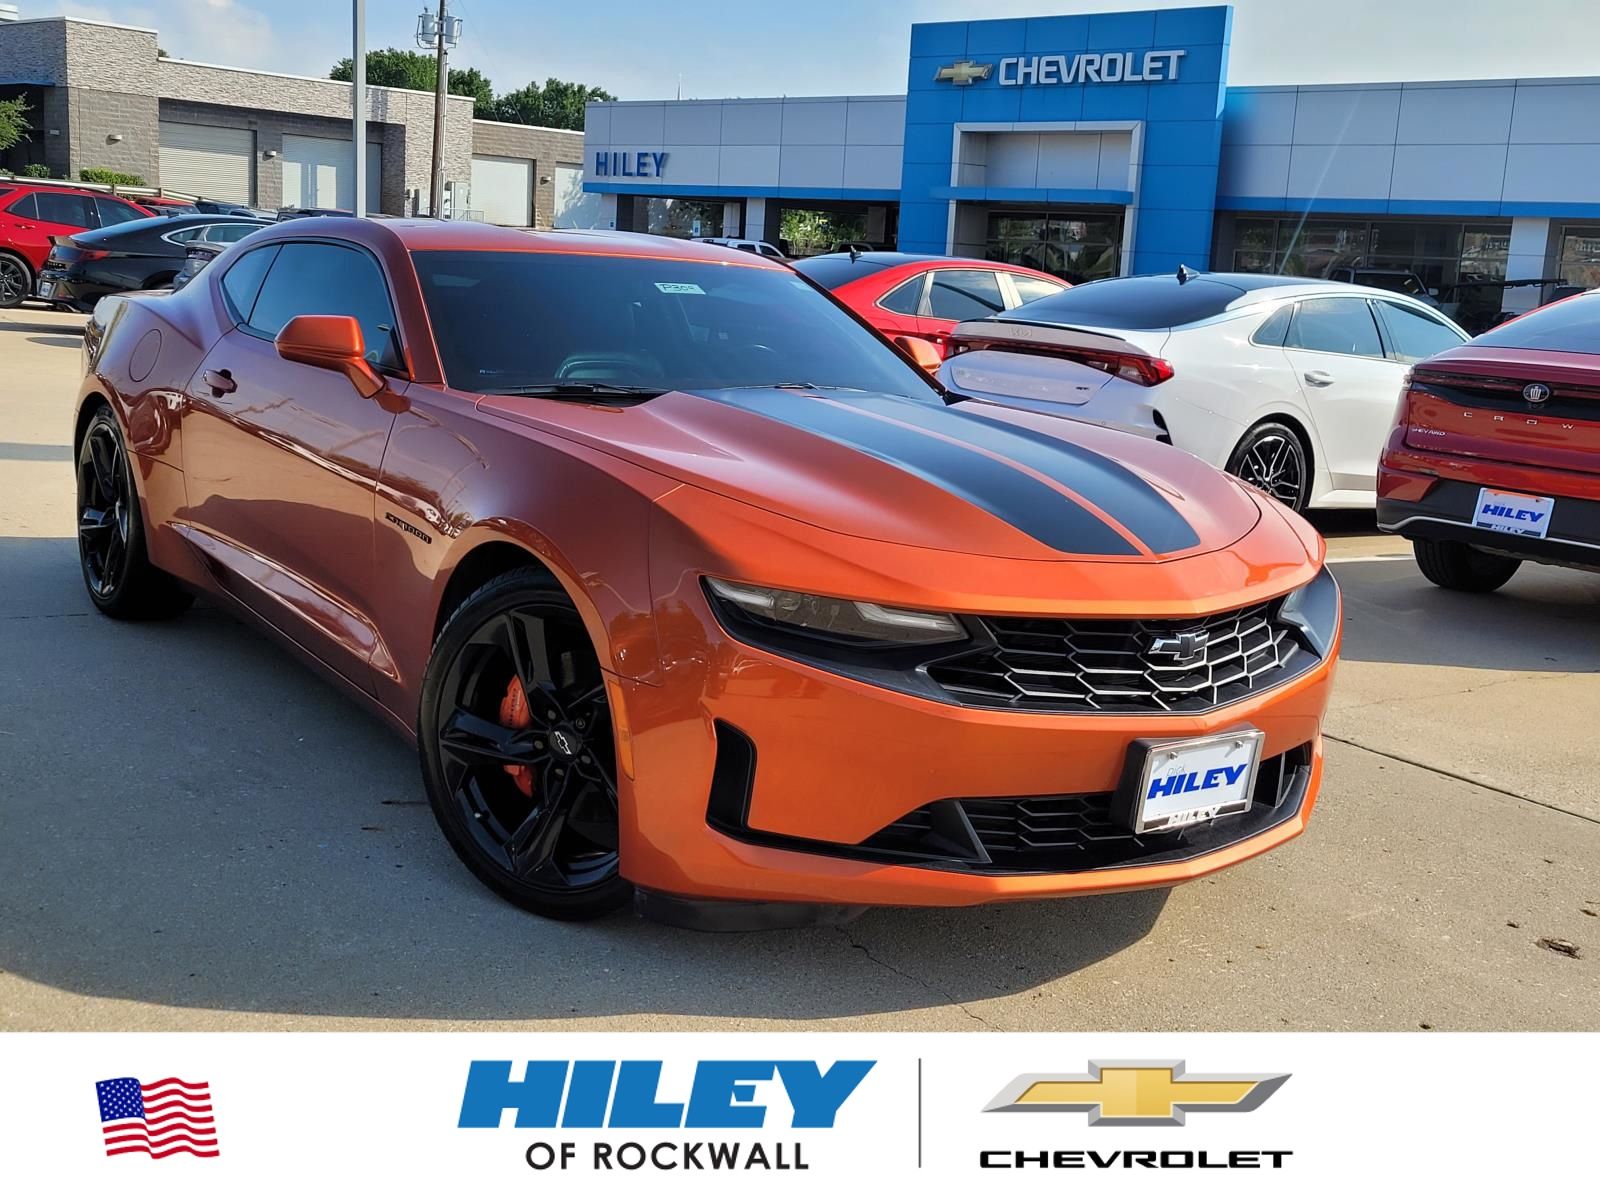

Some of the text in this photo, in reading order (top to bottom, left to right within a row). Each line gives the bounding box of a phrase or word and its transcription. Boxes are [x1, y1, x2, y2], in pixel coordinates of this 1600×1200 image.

[999, 50, 1186, 86] CHEVROLET
[595, 152, 667, 177] HILEY
[1482, 504, 1544, 522] HILEY
[1147, 763, 1248, 800] HILEY
